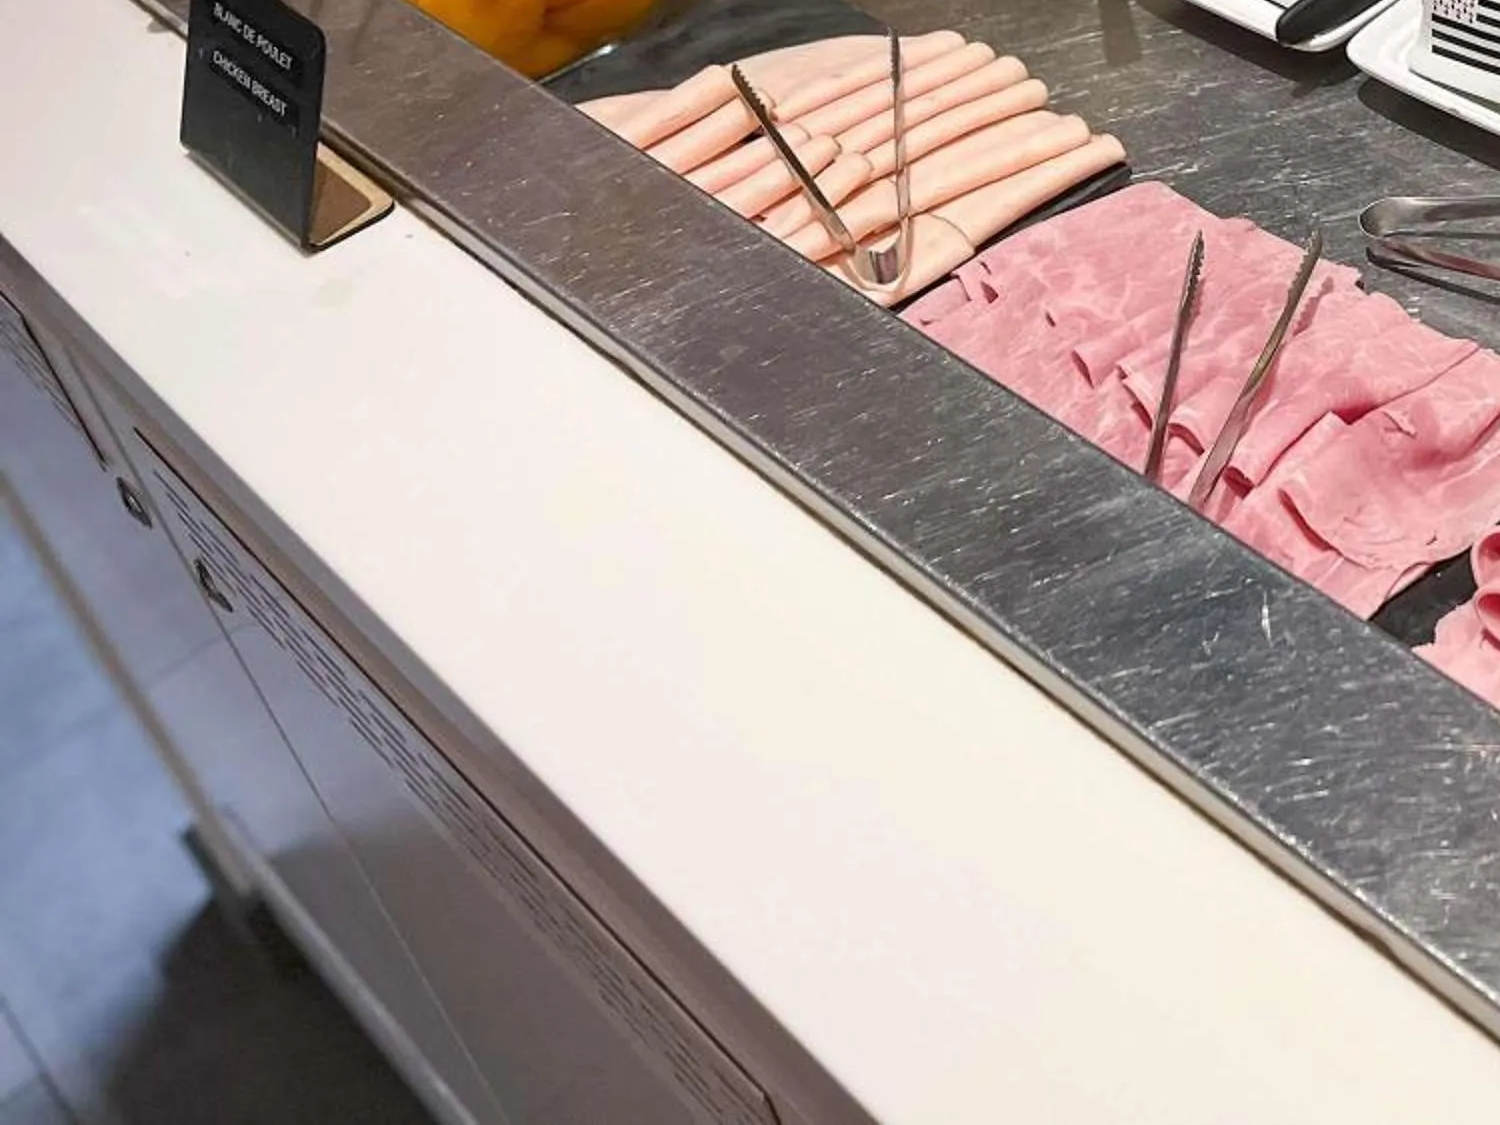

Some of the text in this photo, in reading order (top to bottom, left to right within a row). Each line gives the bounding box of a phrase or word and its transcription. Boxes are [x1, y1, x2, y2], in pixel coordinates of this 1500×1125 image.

[213, 2, 293, 70] BLANC DE POULET
[213, 50, 287, 116] CHICKEN BREAST
